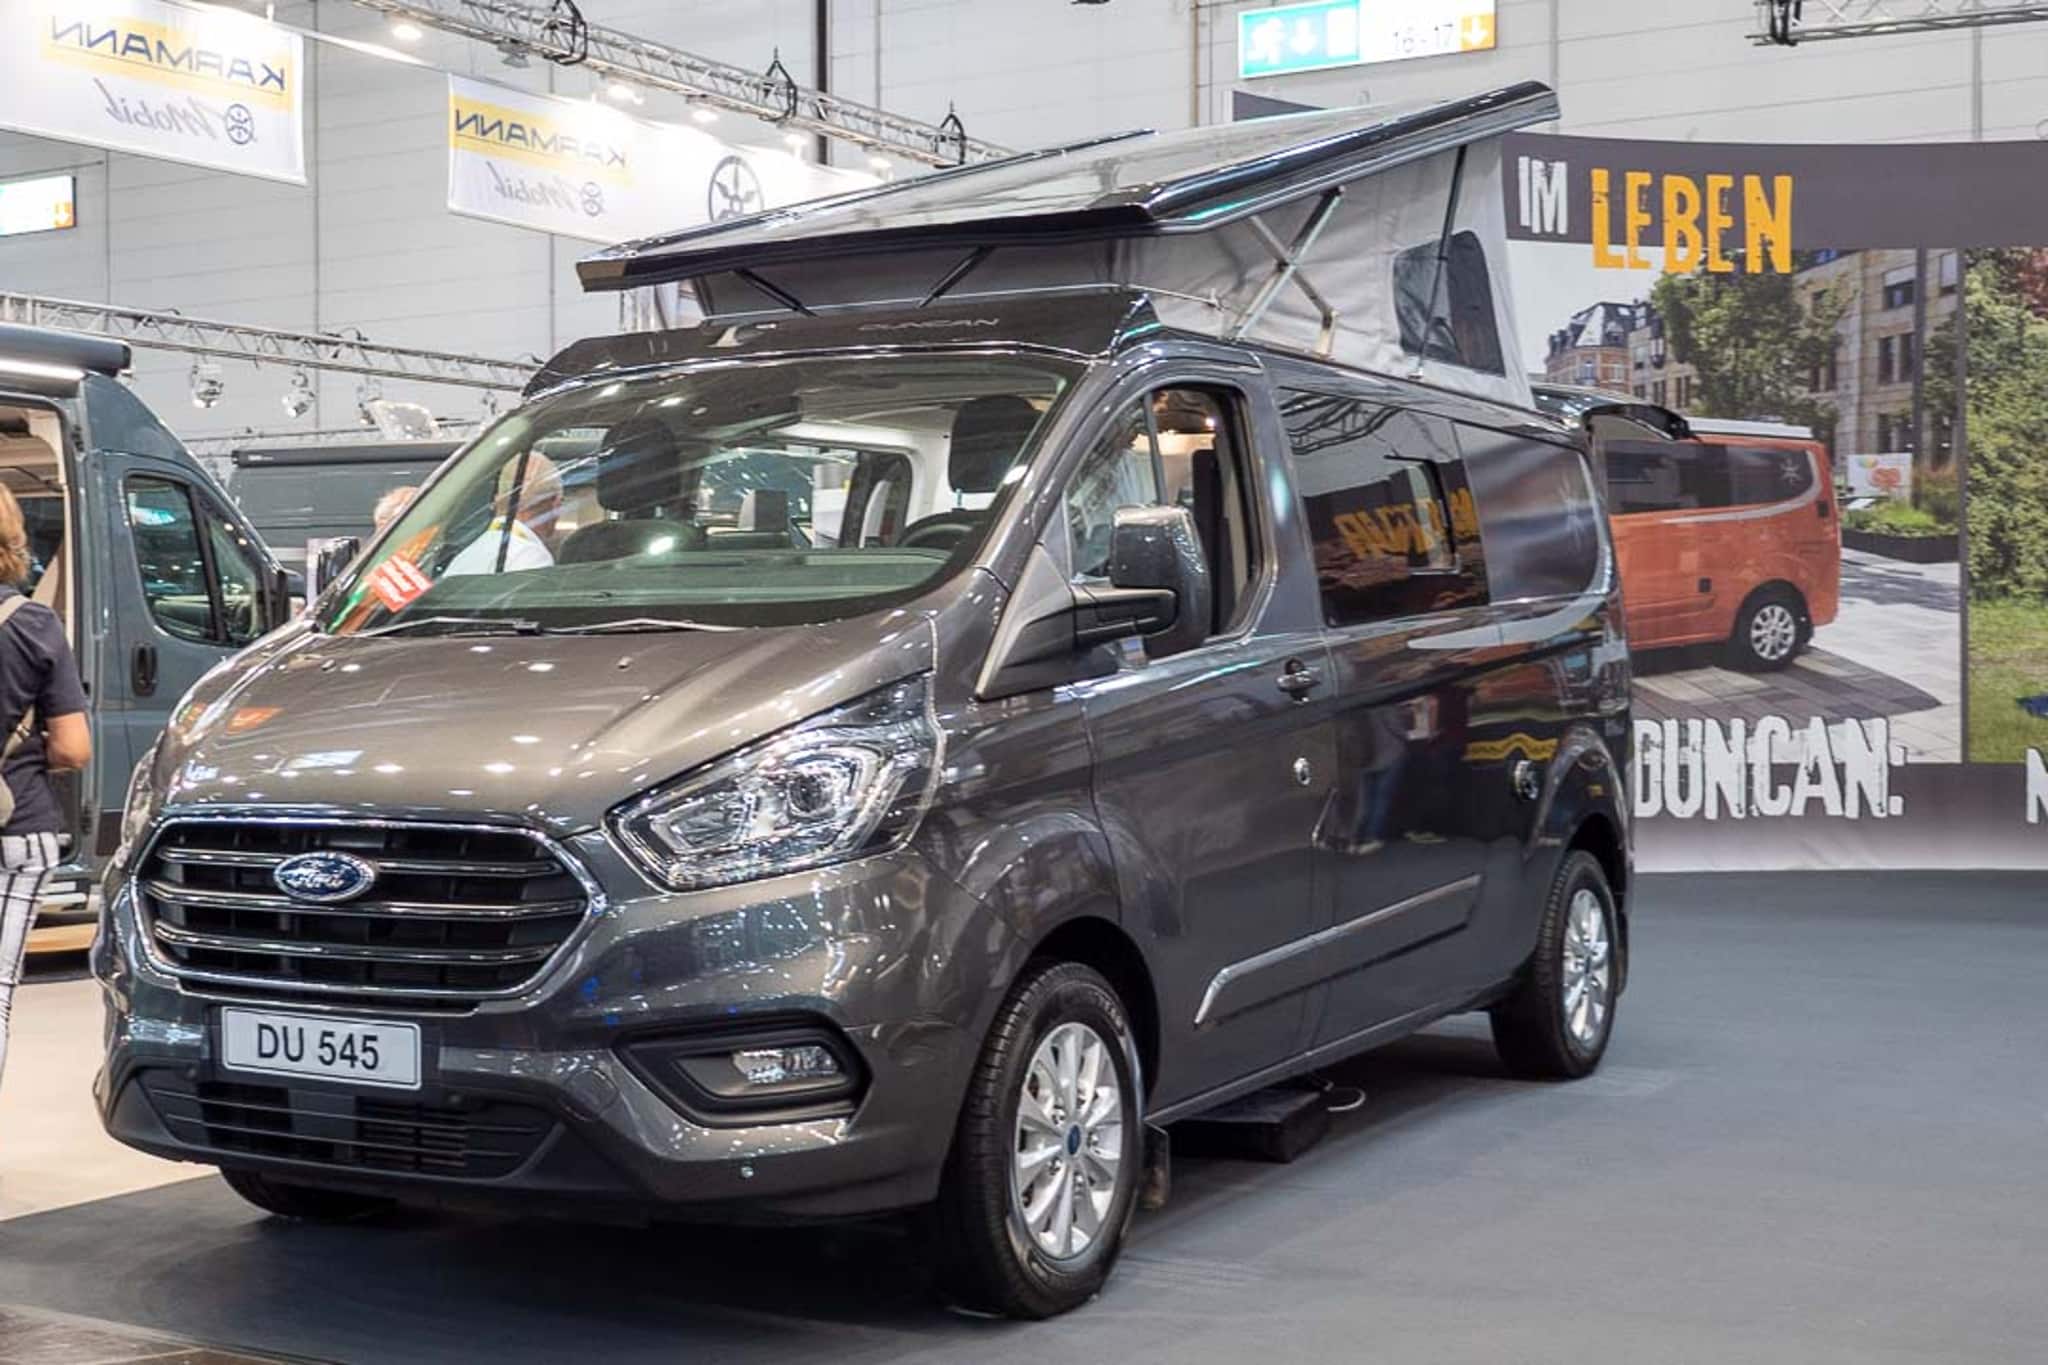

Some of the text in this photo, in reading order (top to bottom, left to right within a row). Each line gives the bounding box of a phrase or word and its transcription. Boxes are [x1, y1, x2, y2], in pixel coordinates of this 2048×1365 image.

[1518, 155, 1793, 274] IM LEBEN
[257, 1023, 379, 1070] DU 545
